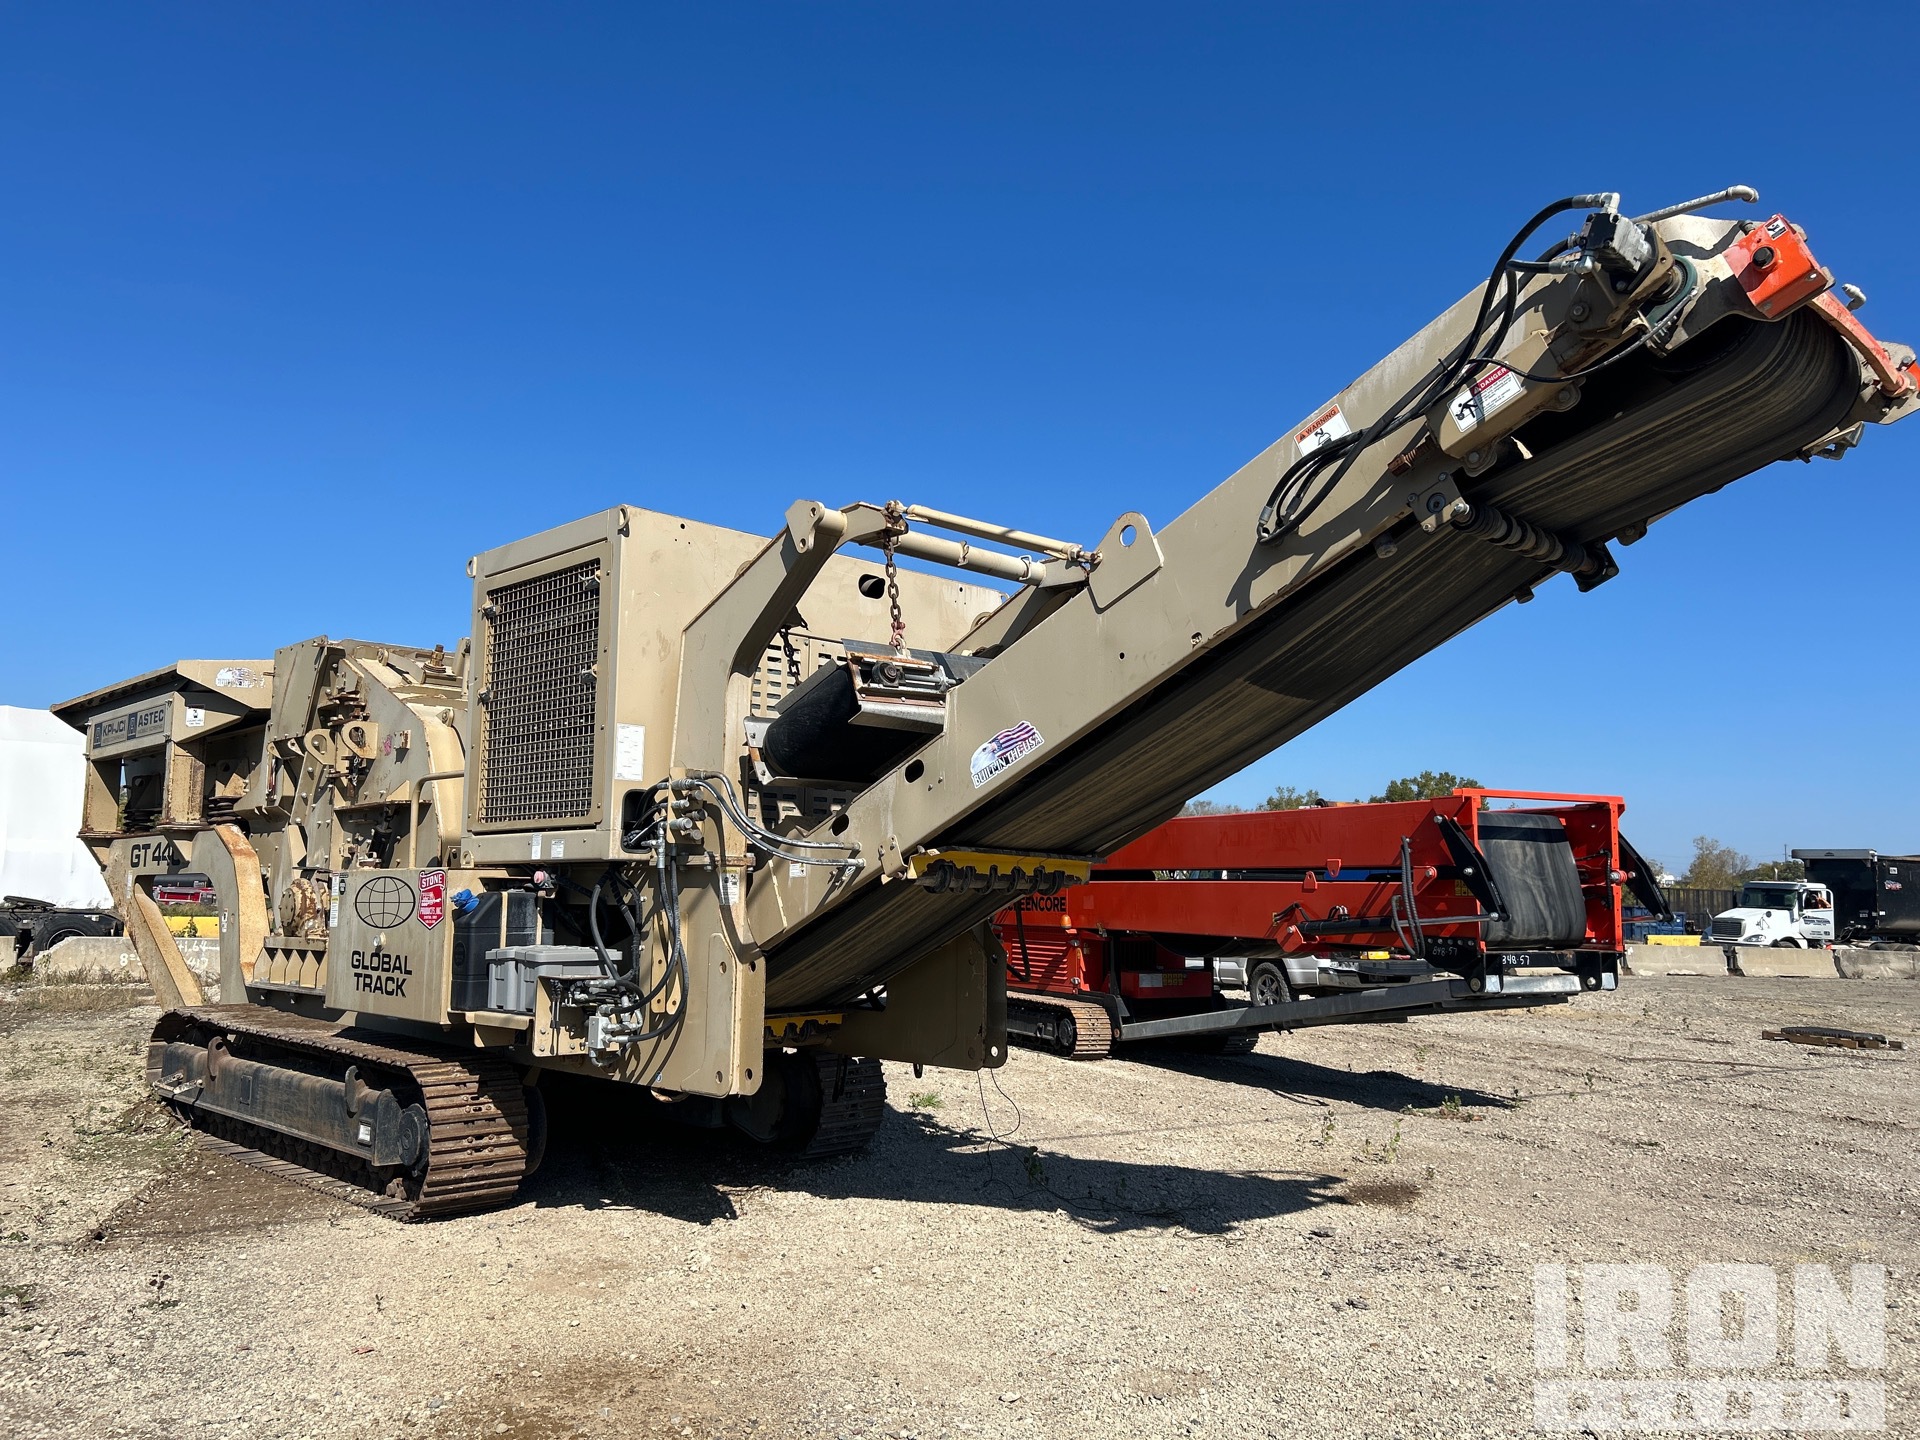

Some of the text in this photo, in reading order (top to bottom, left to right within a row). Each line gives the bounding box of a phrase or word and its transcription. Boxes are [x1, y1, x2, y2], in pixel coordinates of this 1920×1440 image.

[1480, 367, 1507, 389] DANGER
[1305, 409, 1337, 435] WARNING
[138, 709, 164, 727] ASTEC
[973, 763, 997, 786] BUILT
[1004, 744, 1025, 763] THE
[1023, 733, 1042, 752] USA
[421, 873, 443, 888] STONE
[351, 950, 413, 976] GLOBAL
[353, 972, 407, 998] TRACK
